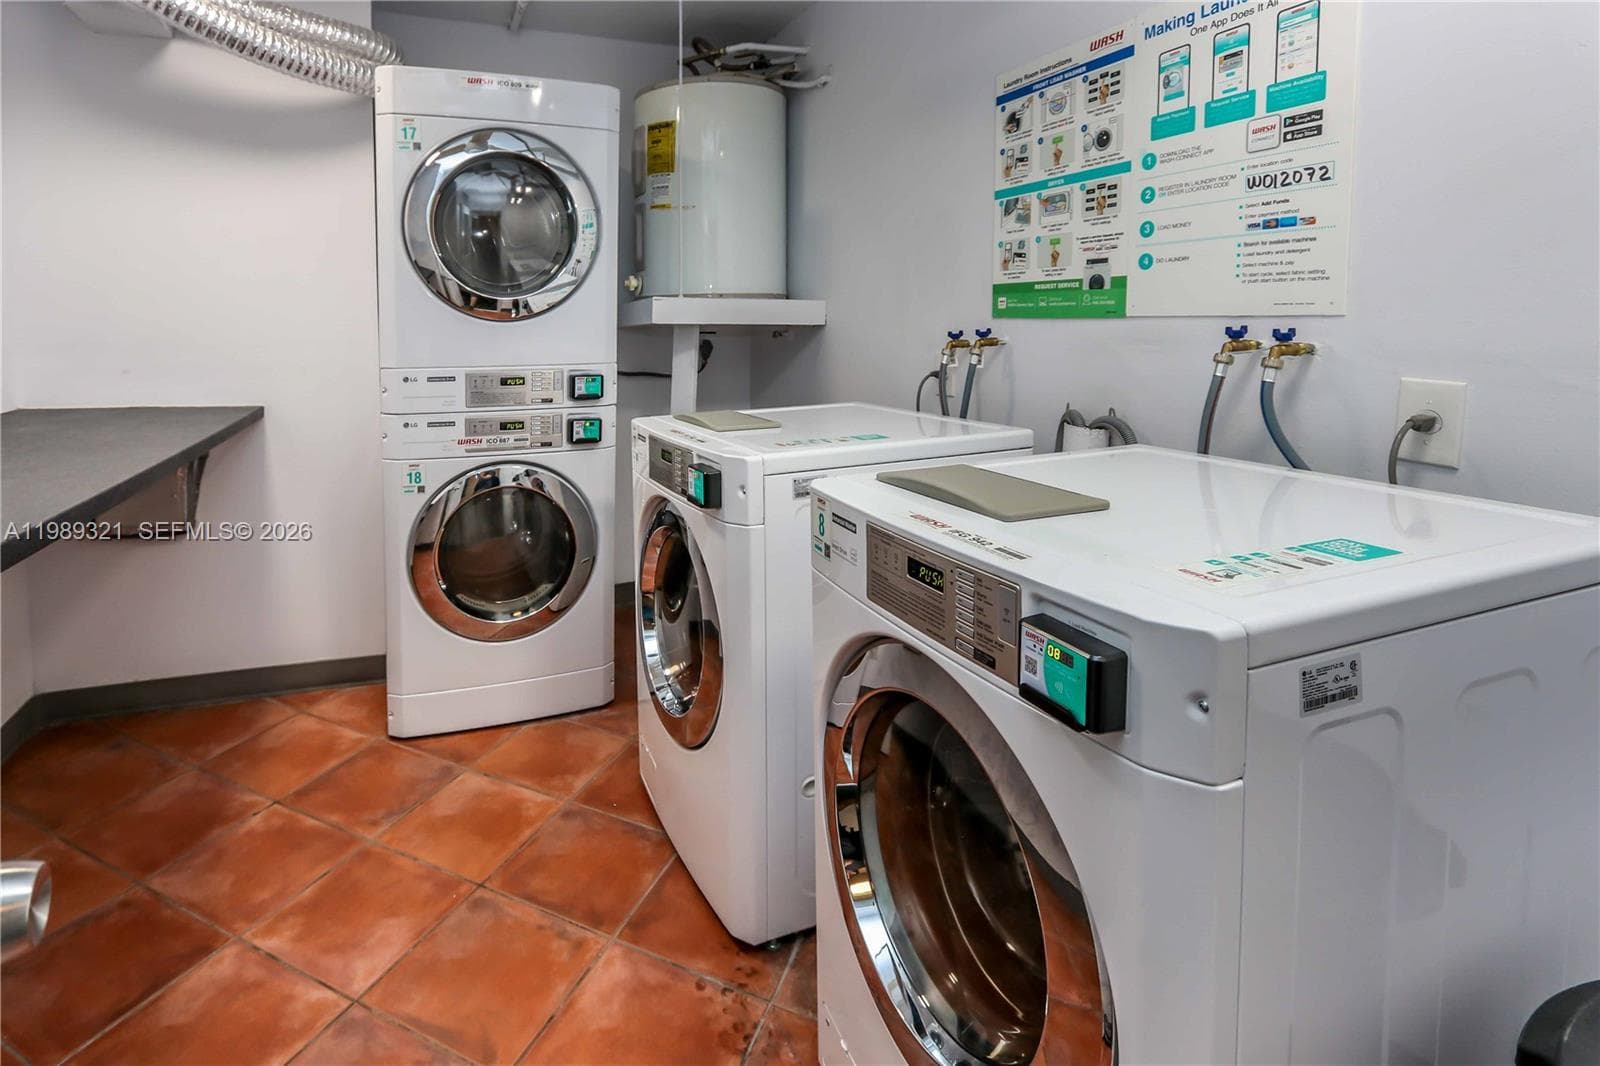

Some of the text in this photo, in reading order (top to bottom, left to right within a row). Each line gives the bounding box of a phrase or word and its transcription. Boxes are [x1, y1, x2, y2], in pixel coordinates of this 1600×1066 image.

[1144, 0, 1248, 40] Making Laun
[1190, 26, 1208, 36] One
[1210, 18, 1228, 28] App
[1231, 8, 1254, 22] Does
[1258, 4, 1264, 12] It
[1090, 30, 1124, 52] WASH
[401, 127, 416, 140] 17
[1252, 124, 1276, 134] WASH
[1176, 151, 1202, 160] CONNECT
[1186, 184, 1212, 193] LOCATION
[1172, 221, 1192, 229] MONEY
[407, 472, 421, 484] 18
[819, 512, 824, 537] 8
[920, 566, 944, 588] PUSH
[1024, 630, 1044, 645] WASH
[1047, 644, 1061, 660] 08
